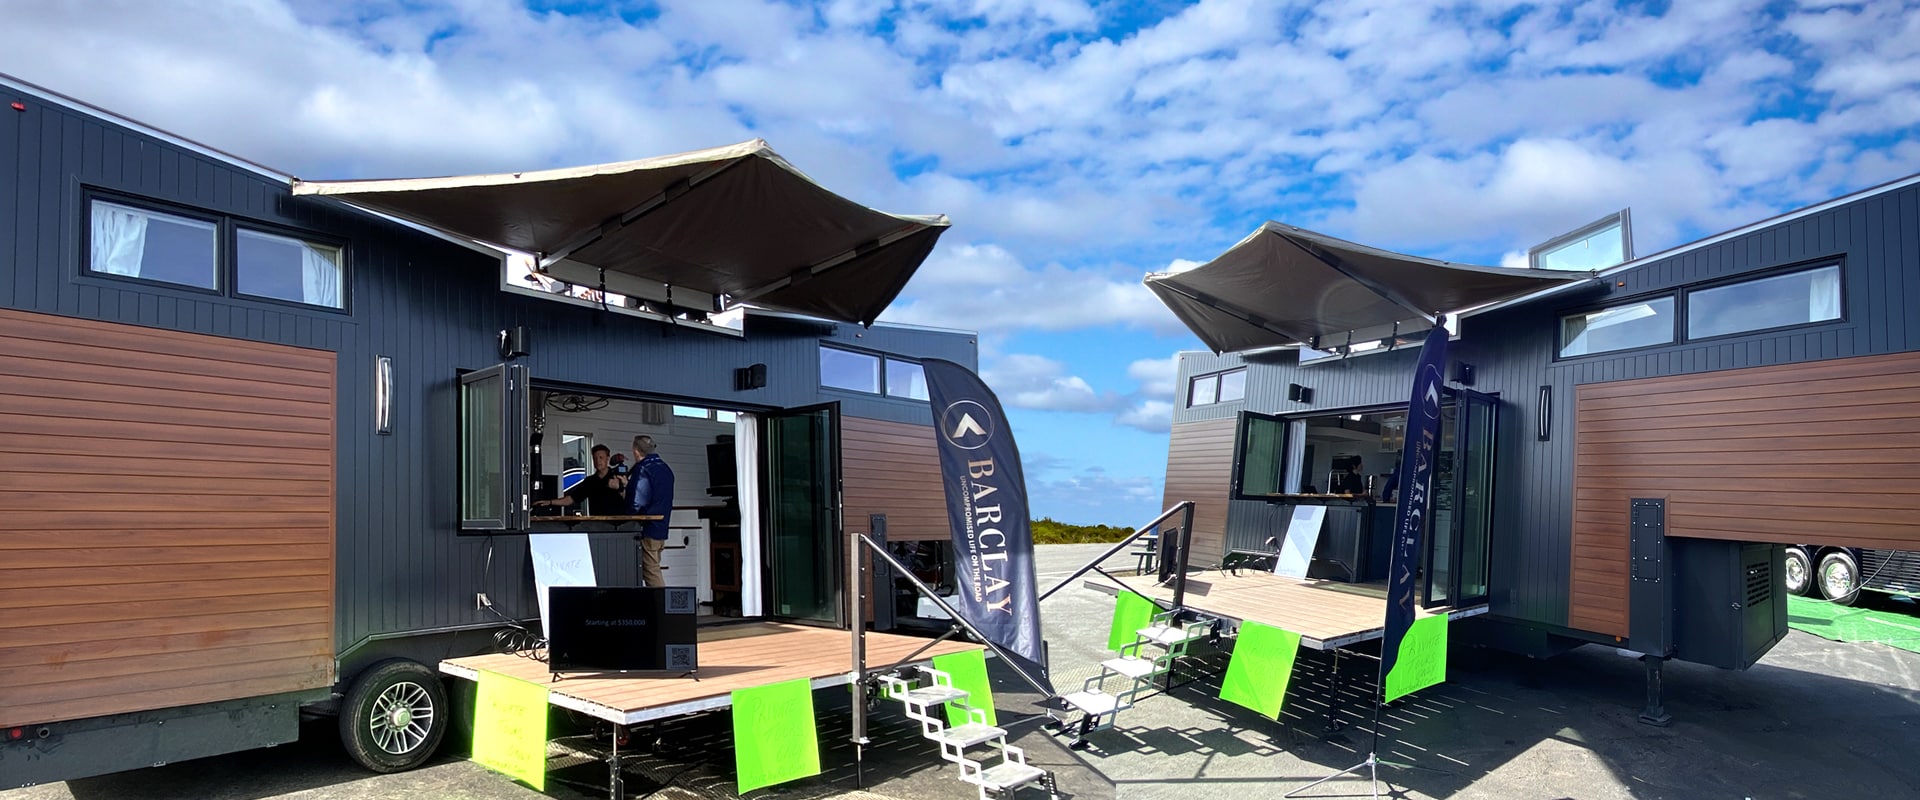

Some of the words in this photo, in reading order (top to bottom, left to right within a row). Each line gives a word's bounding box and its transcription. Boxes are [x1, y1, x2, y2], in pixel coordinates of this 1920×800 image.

[960, 475, 974, 540] UNCOMPROMISED
[967, 457, 1012, 616] BARCLAY
[968, 540, 976, 554] LIFE
[971, 555, 979, 567] ON
[972, 567, 980, 581] THE
[974, 581, 982, 603] ROAD
[585, 619, 609, 627] Starting
